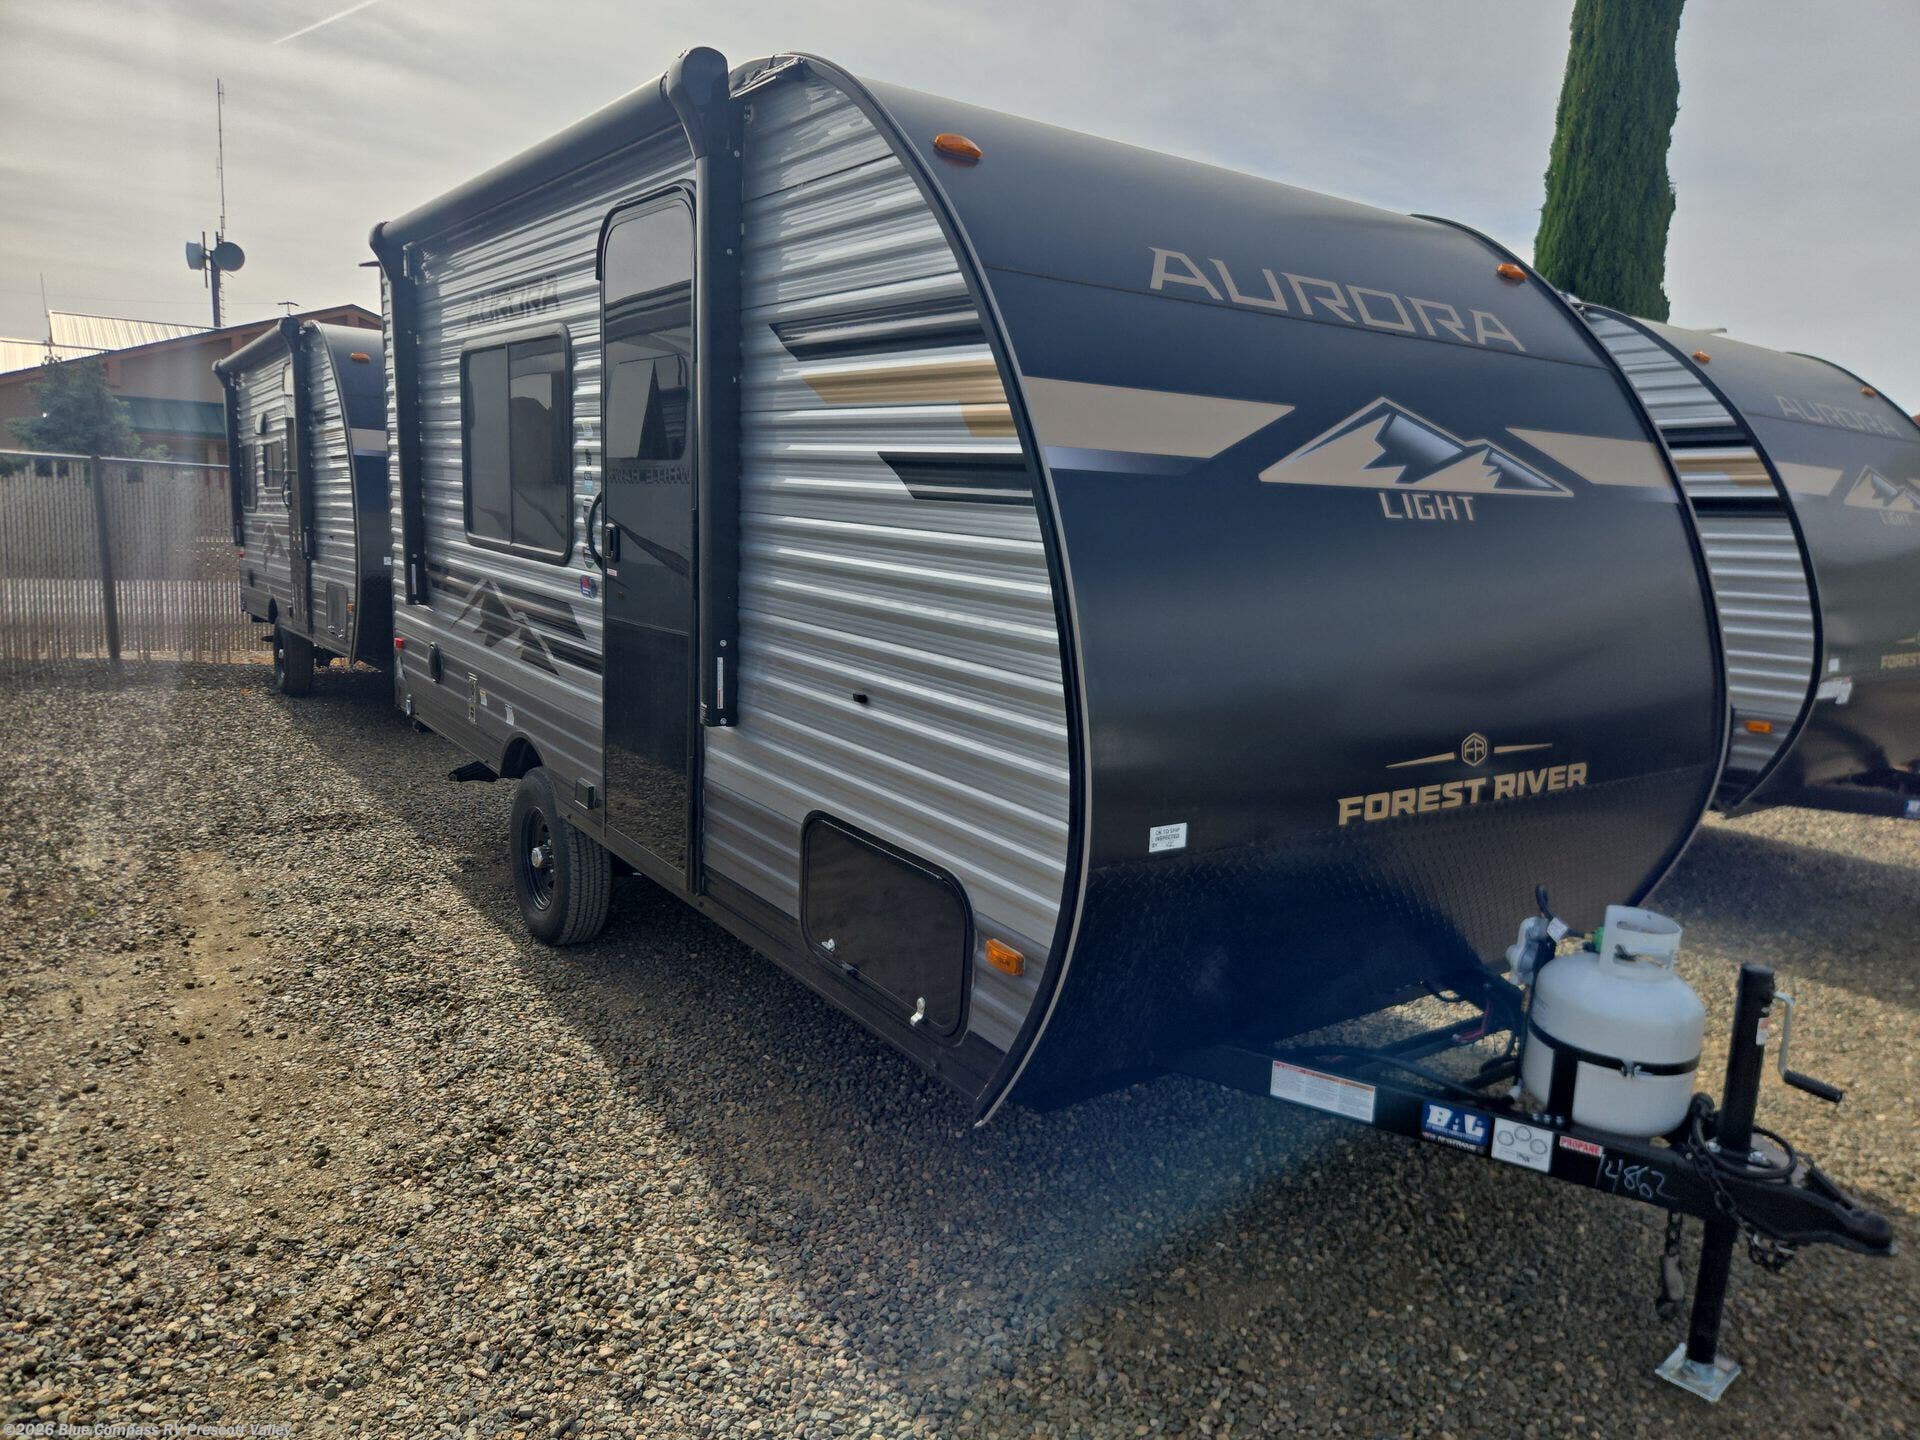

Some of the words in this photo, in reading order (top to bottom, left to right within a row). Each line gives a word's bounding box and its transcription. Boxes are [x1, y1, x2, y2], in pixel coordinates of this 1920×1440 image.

[1147, 246, 1527, 353] AURORA
[1775, 395, 1902, 439] AURORA
[1379, 492, 1475, 522] LIGHT
[1337, 777, 1487, 826] FOREST
[1493, 762, 1588, 801] RIVER
[1560, 1136, 1602, 1157] PROPANE
